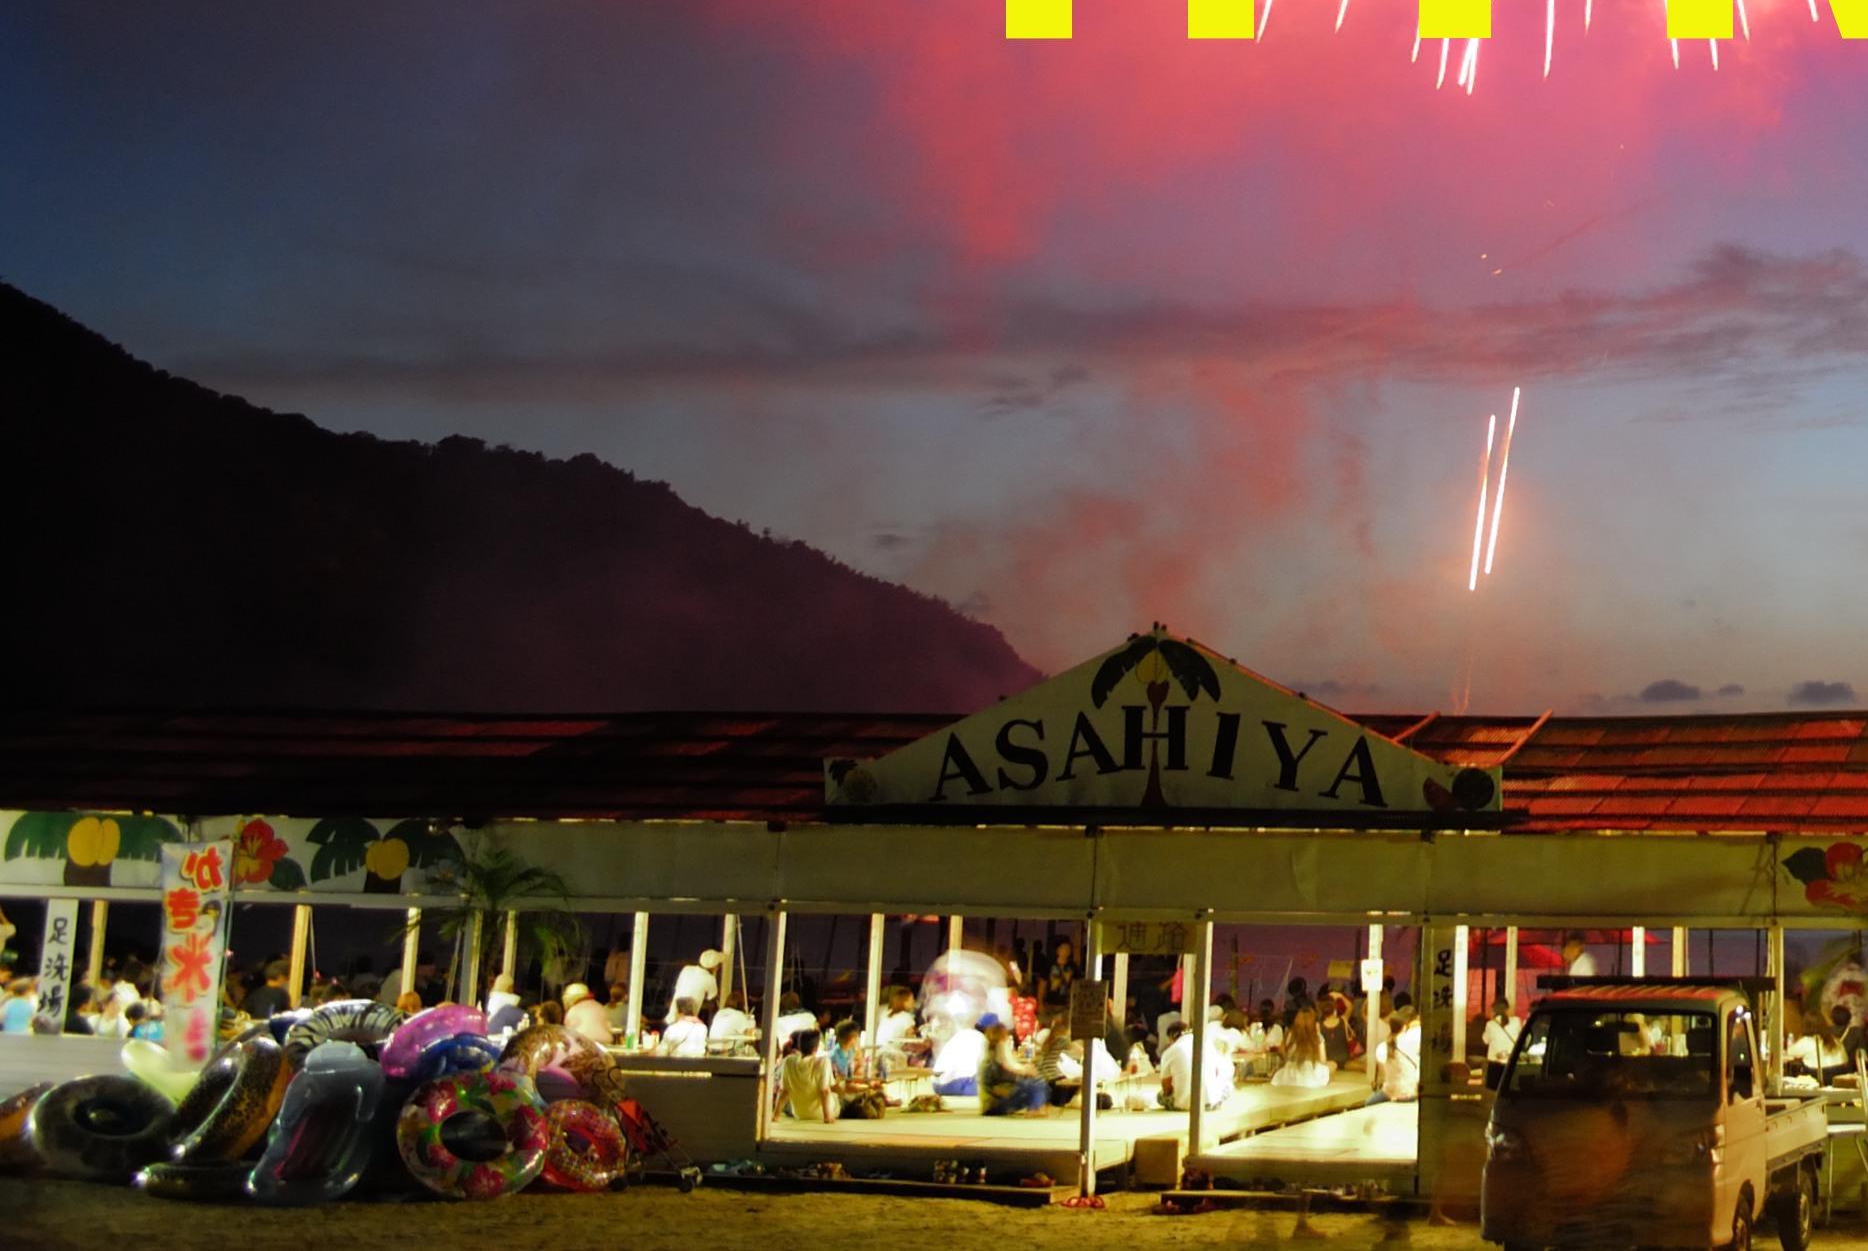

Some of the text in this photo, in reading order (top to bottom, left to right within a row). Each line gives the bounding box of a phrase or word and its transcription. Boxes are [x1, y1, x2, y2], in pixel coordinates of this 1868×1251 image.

[931, 706, 1388, 808] ASAHIYA
[39, 917, 70, 1018] 足洗場
